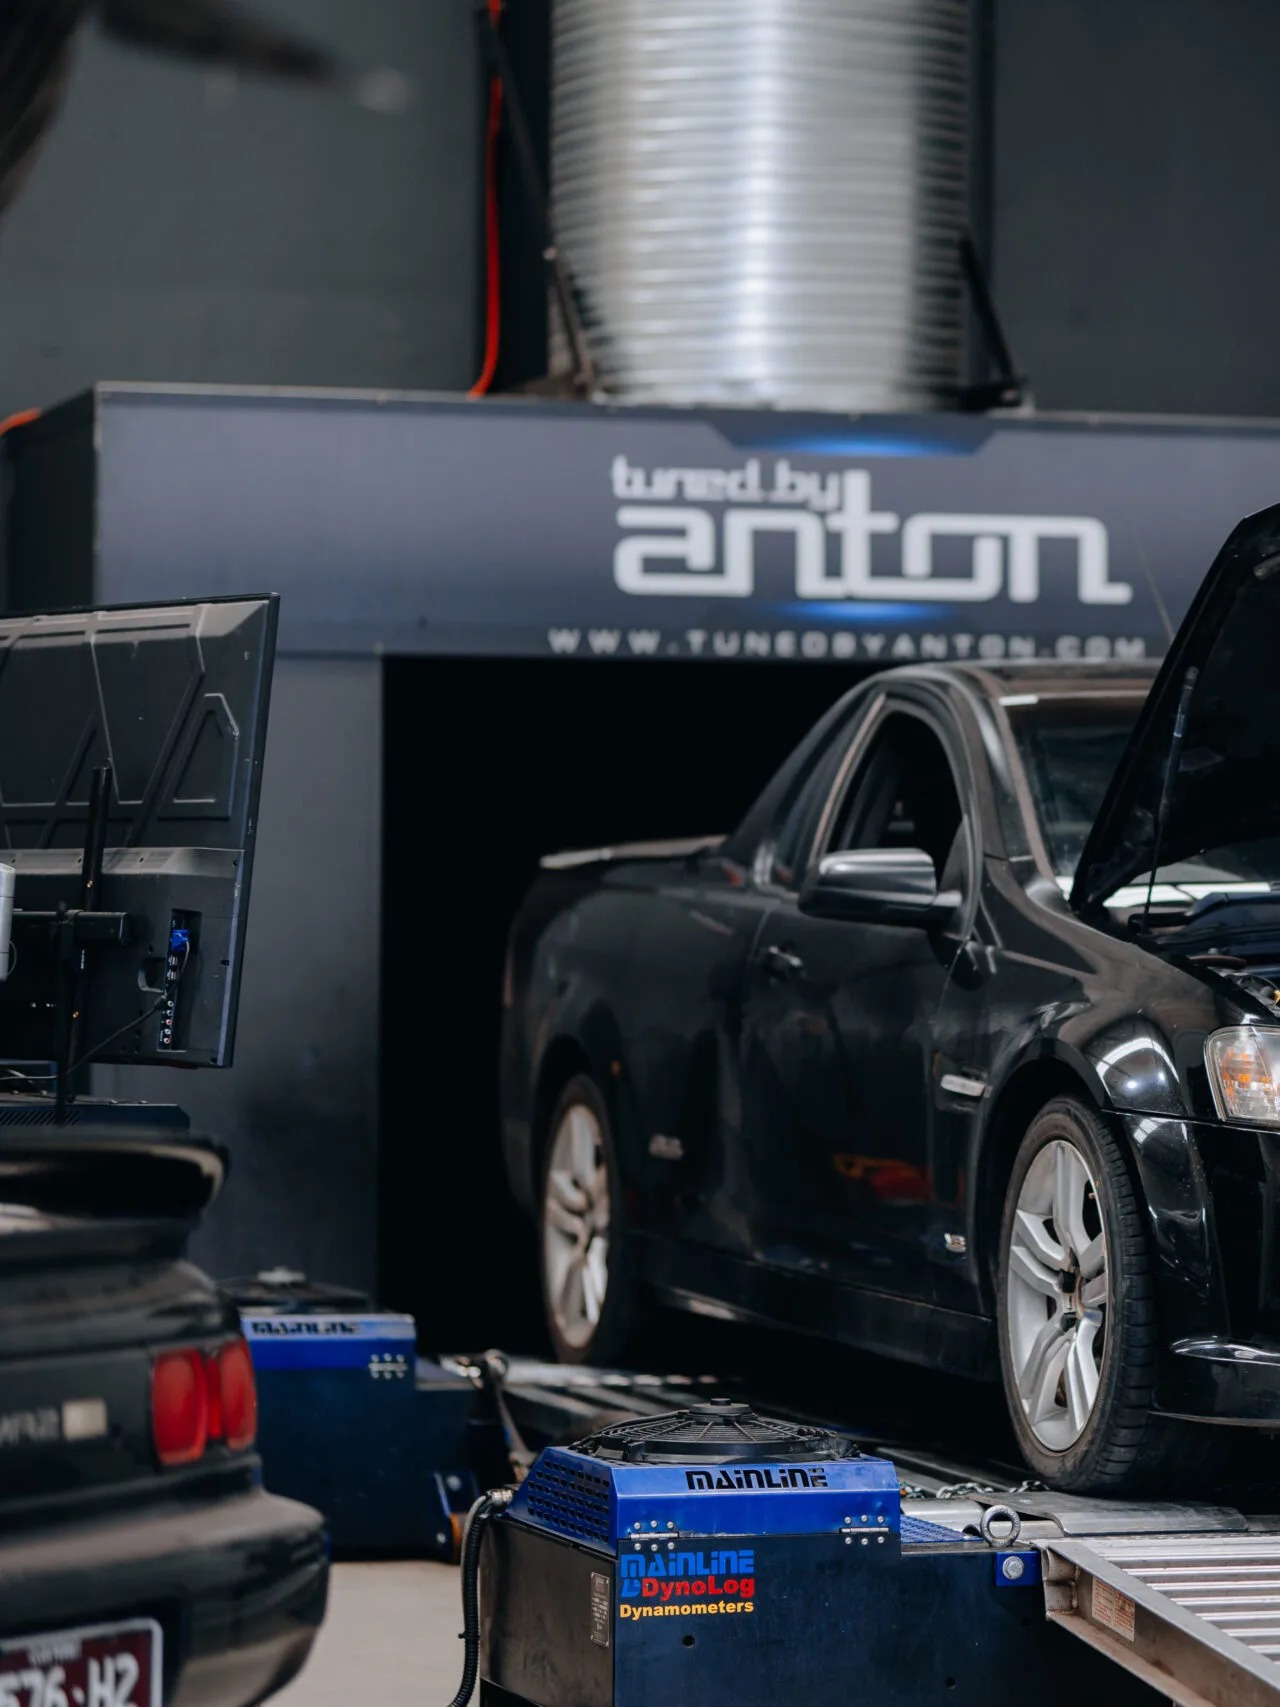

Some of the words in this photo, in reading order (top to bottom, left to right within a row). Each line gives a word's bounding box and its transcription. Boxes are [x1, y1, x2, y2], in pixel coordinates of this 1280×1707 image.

[611, 453, 765, 501] tuned
[769, 458, 841, 512] by
[613, 469, 1134, 605] anton
[547, 627, 1147, 660] WWW.TUNEDBYANTON.COM
[642, 1575, 755, 1602] DynoLog
[619, 1600, 754, 1621] Dynamometers
